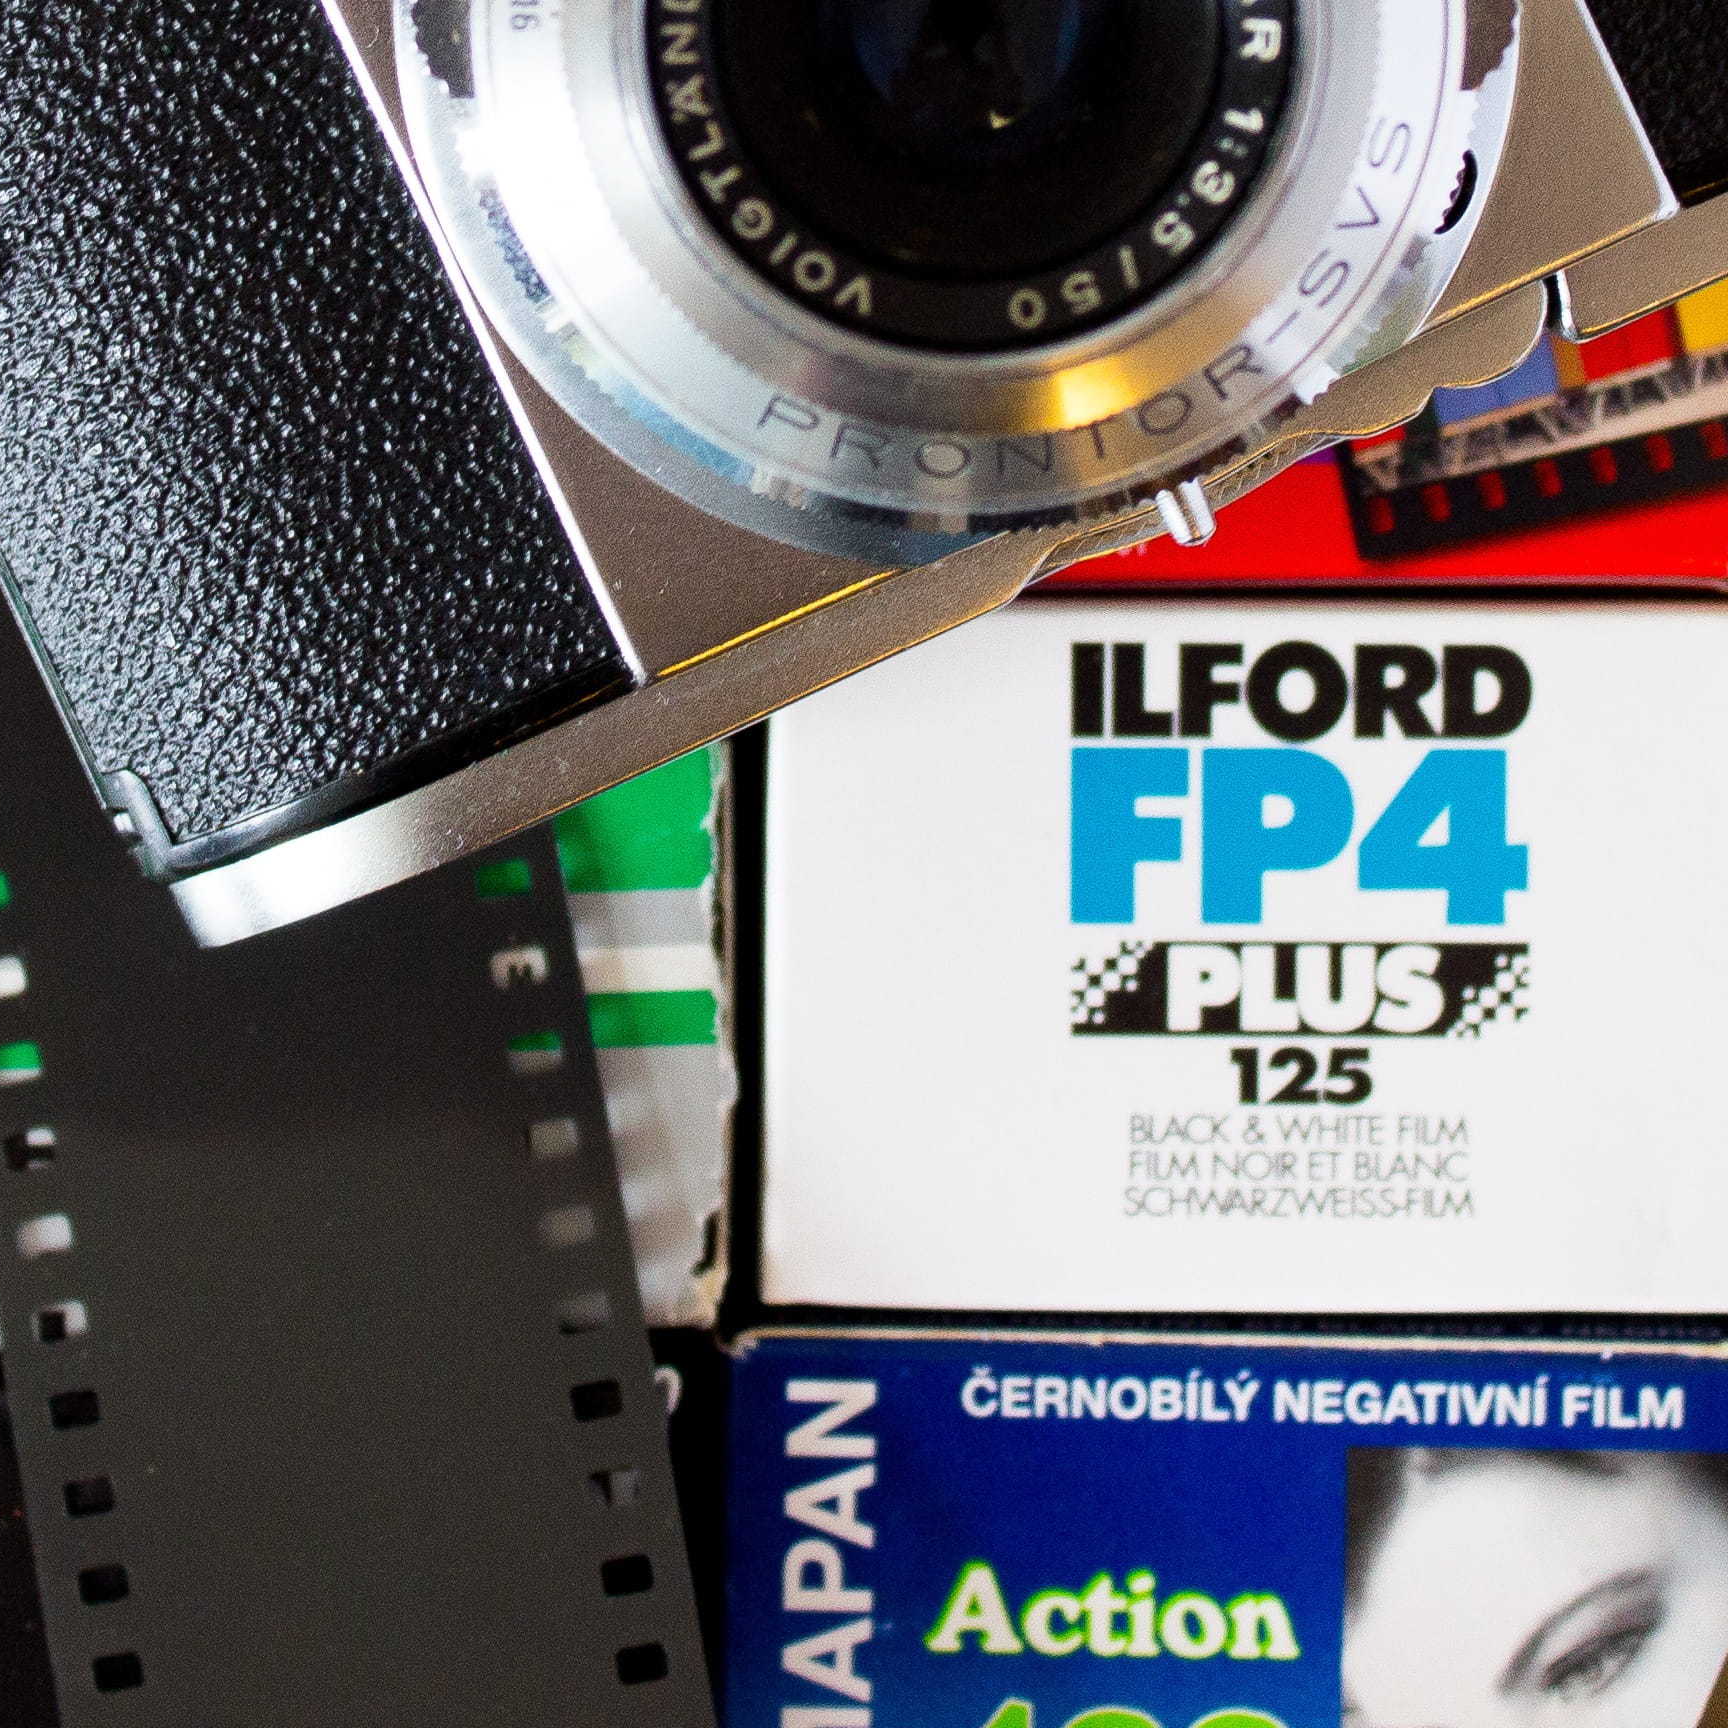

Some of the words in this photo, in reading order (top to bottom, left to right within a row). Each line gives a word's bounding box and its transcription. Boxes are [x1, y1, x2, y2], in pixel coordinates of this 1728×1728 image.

[1070, 640, 1533, 741] ILFORD
[1070, 746, 1530, 926] FP4
[1164, 944, 1450, 1035] PLUS
[1229, 1045, 1375, 1106] 125
[1128, 1114, 1230, 1146] BLACK
[1241, 1114, 1267, 1146] &
[1275, 1114, 1385, 1146] WHITE
[1397, 1114, 1469, 1146] FILM
[1128, 1151, 1200, 1182] FILM
[1211, 1151, 1297, 1182] NOIR
[1307, 1151, 1342, 1182] ET
[1353, 1150, 1469, 1183] BLANC
[960, 1364, 1261, 1425] ČERNOBÍLÝ
[1272, 1374, 1550, 1428] NEGATIVNÍ
[1561, 1384, 1686, 1430] FILM
[925, 1560, 1300, 1660] Action
